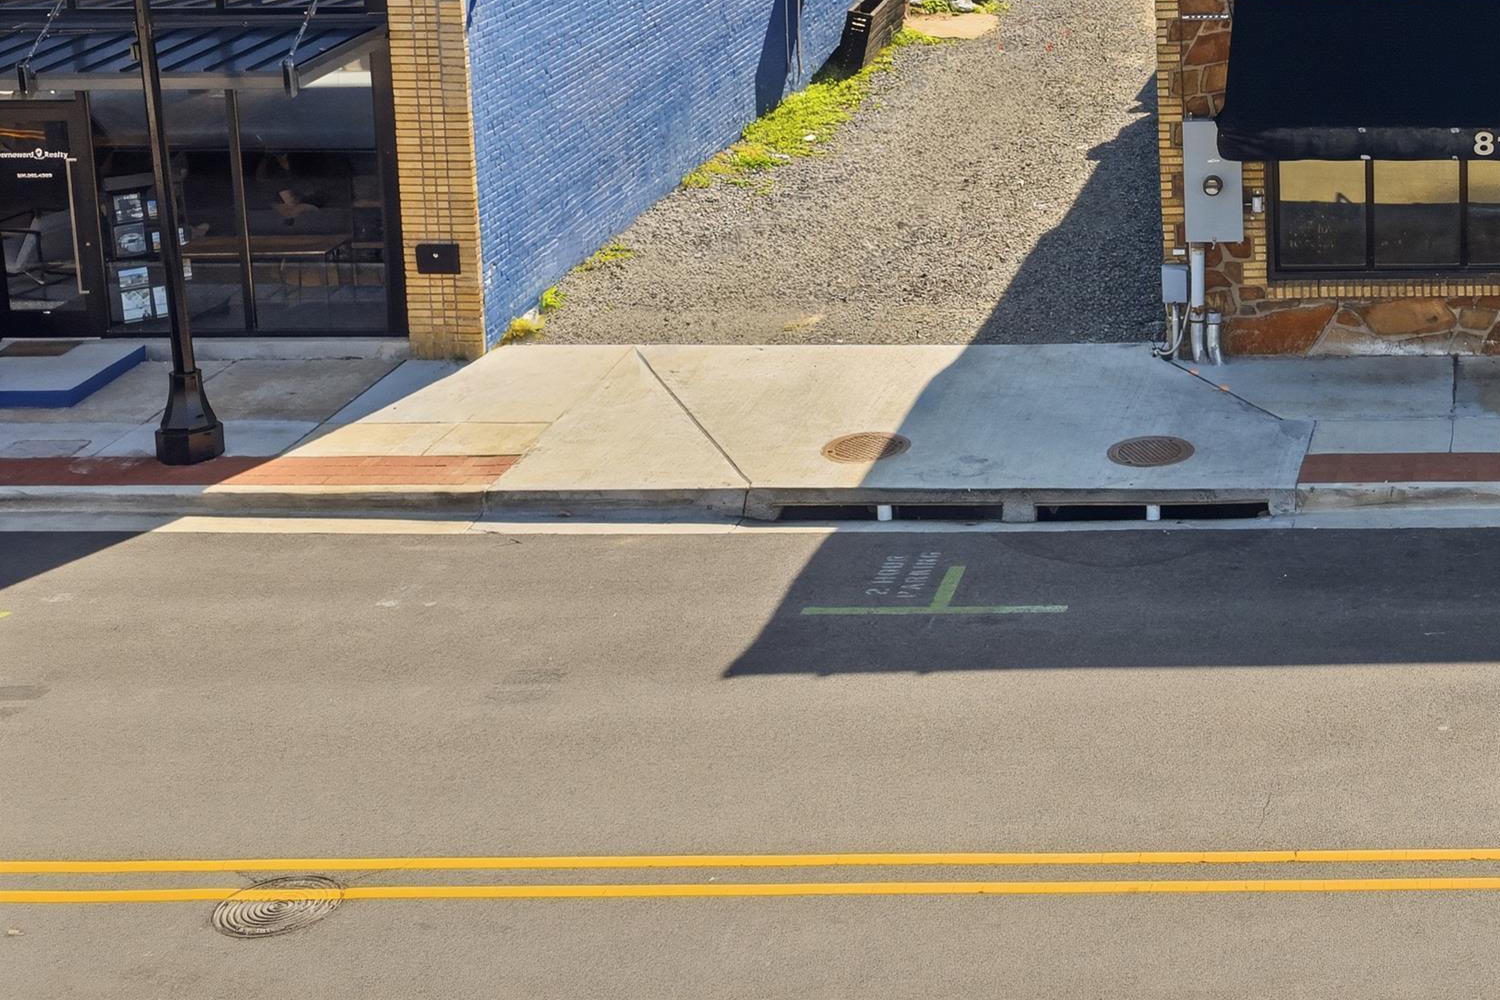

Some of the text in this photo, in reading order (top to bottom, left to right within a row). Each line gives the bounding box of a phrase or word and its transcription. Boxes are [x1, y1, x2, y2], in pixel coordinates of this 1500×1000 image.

[44, 150, 69, 160] Realty
[871, 555, 904, 583] HOUR
[896, 552, 942, 598] PARKING
